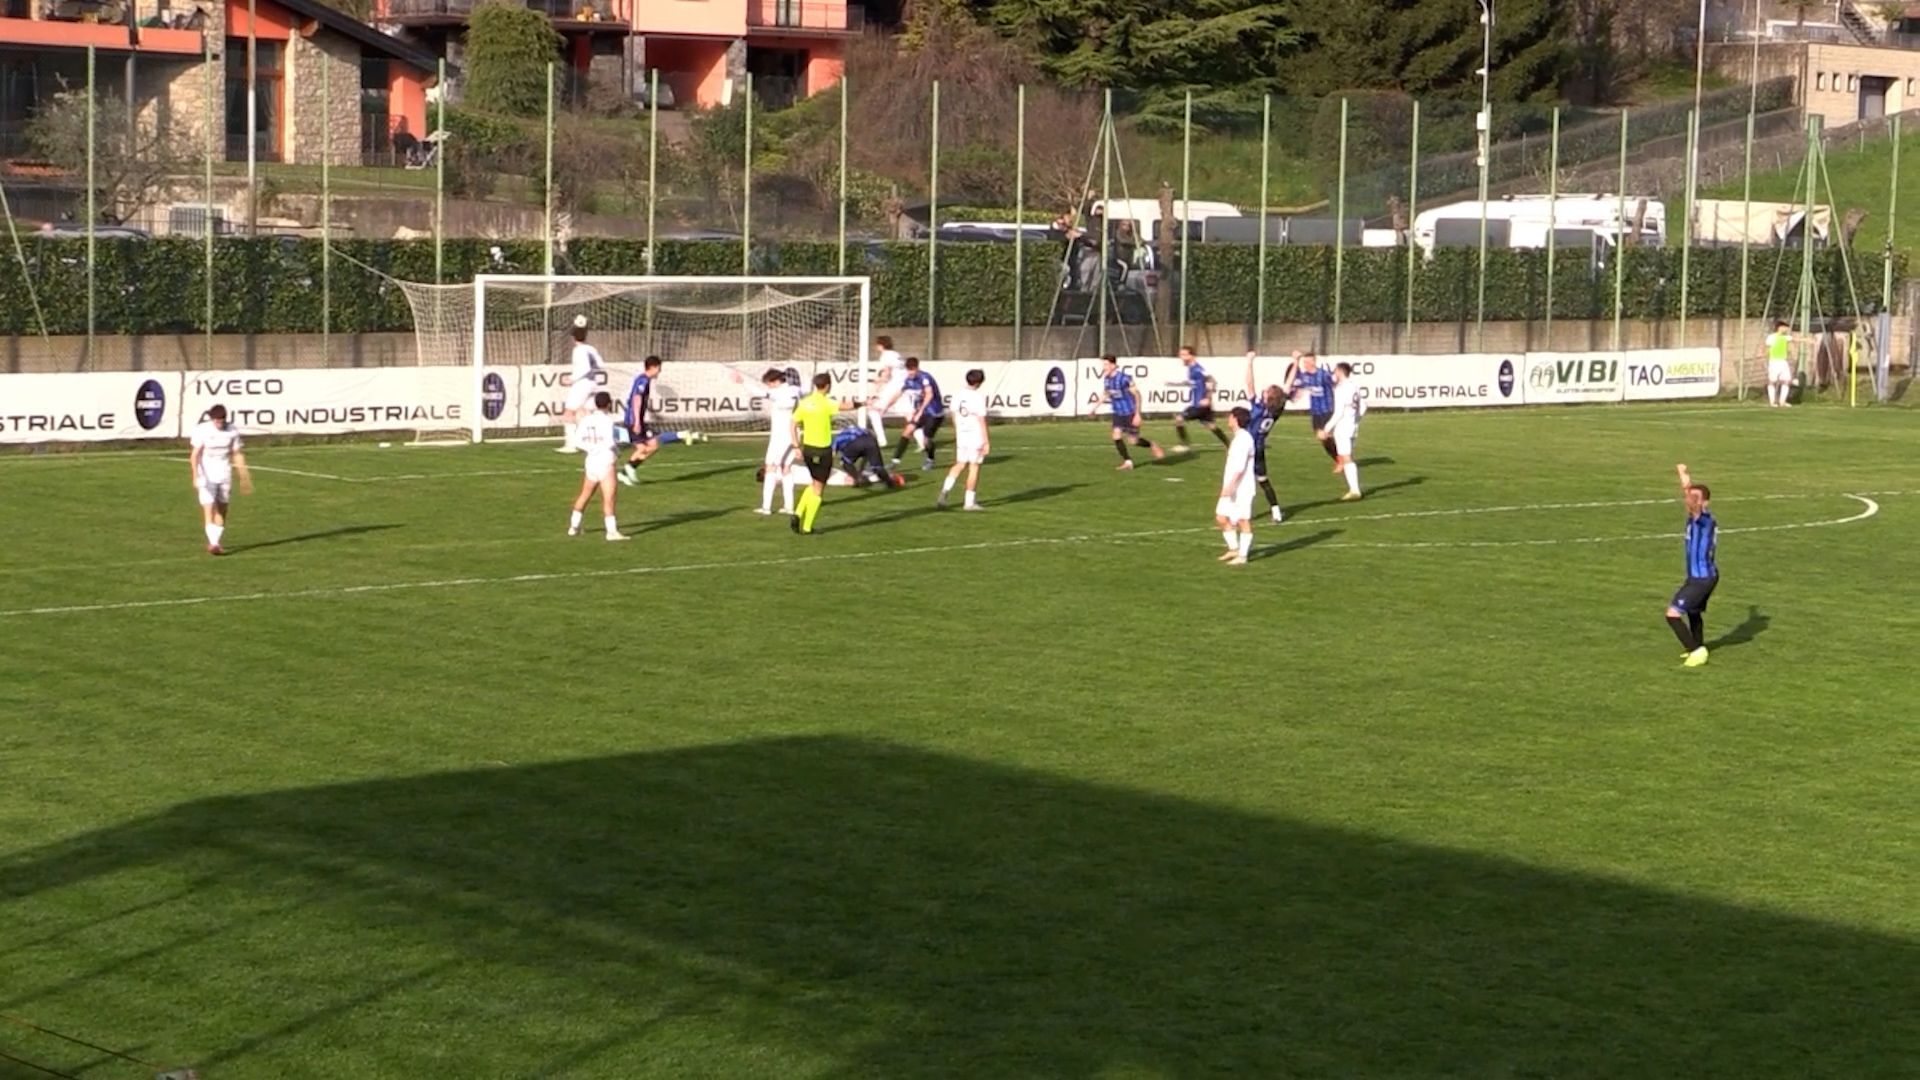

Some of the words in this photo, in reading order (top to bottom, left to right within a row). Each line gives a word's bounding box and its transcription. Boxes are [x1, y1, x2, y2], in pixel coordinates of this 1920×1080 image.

[1556, 359, 1618, 383] VIBI
[1628, 364, 1664, 386] TAO
[1666, 362, 1718, 376] AMBIENTE
[196, 379, 283, 395] IVECO
[1375, 384, 1488, 399] INDUSTRIALE
[286, 404, 462, 425] INDUSTRIALE
